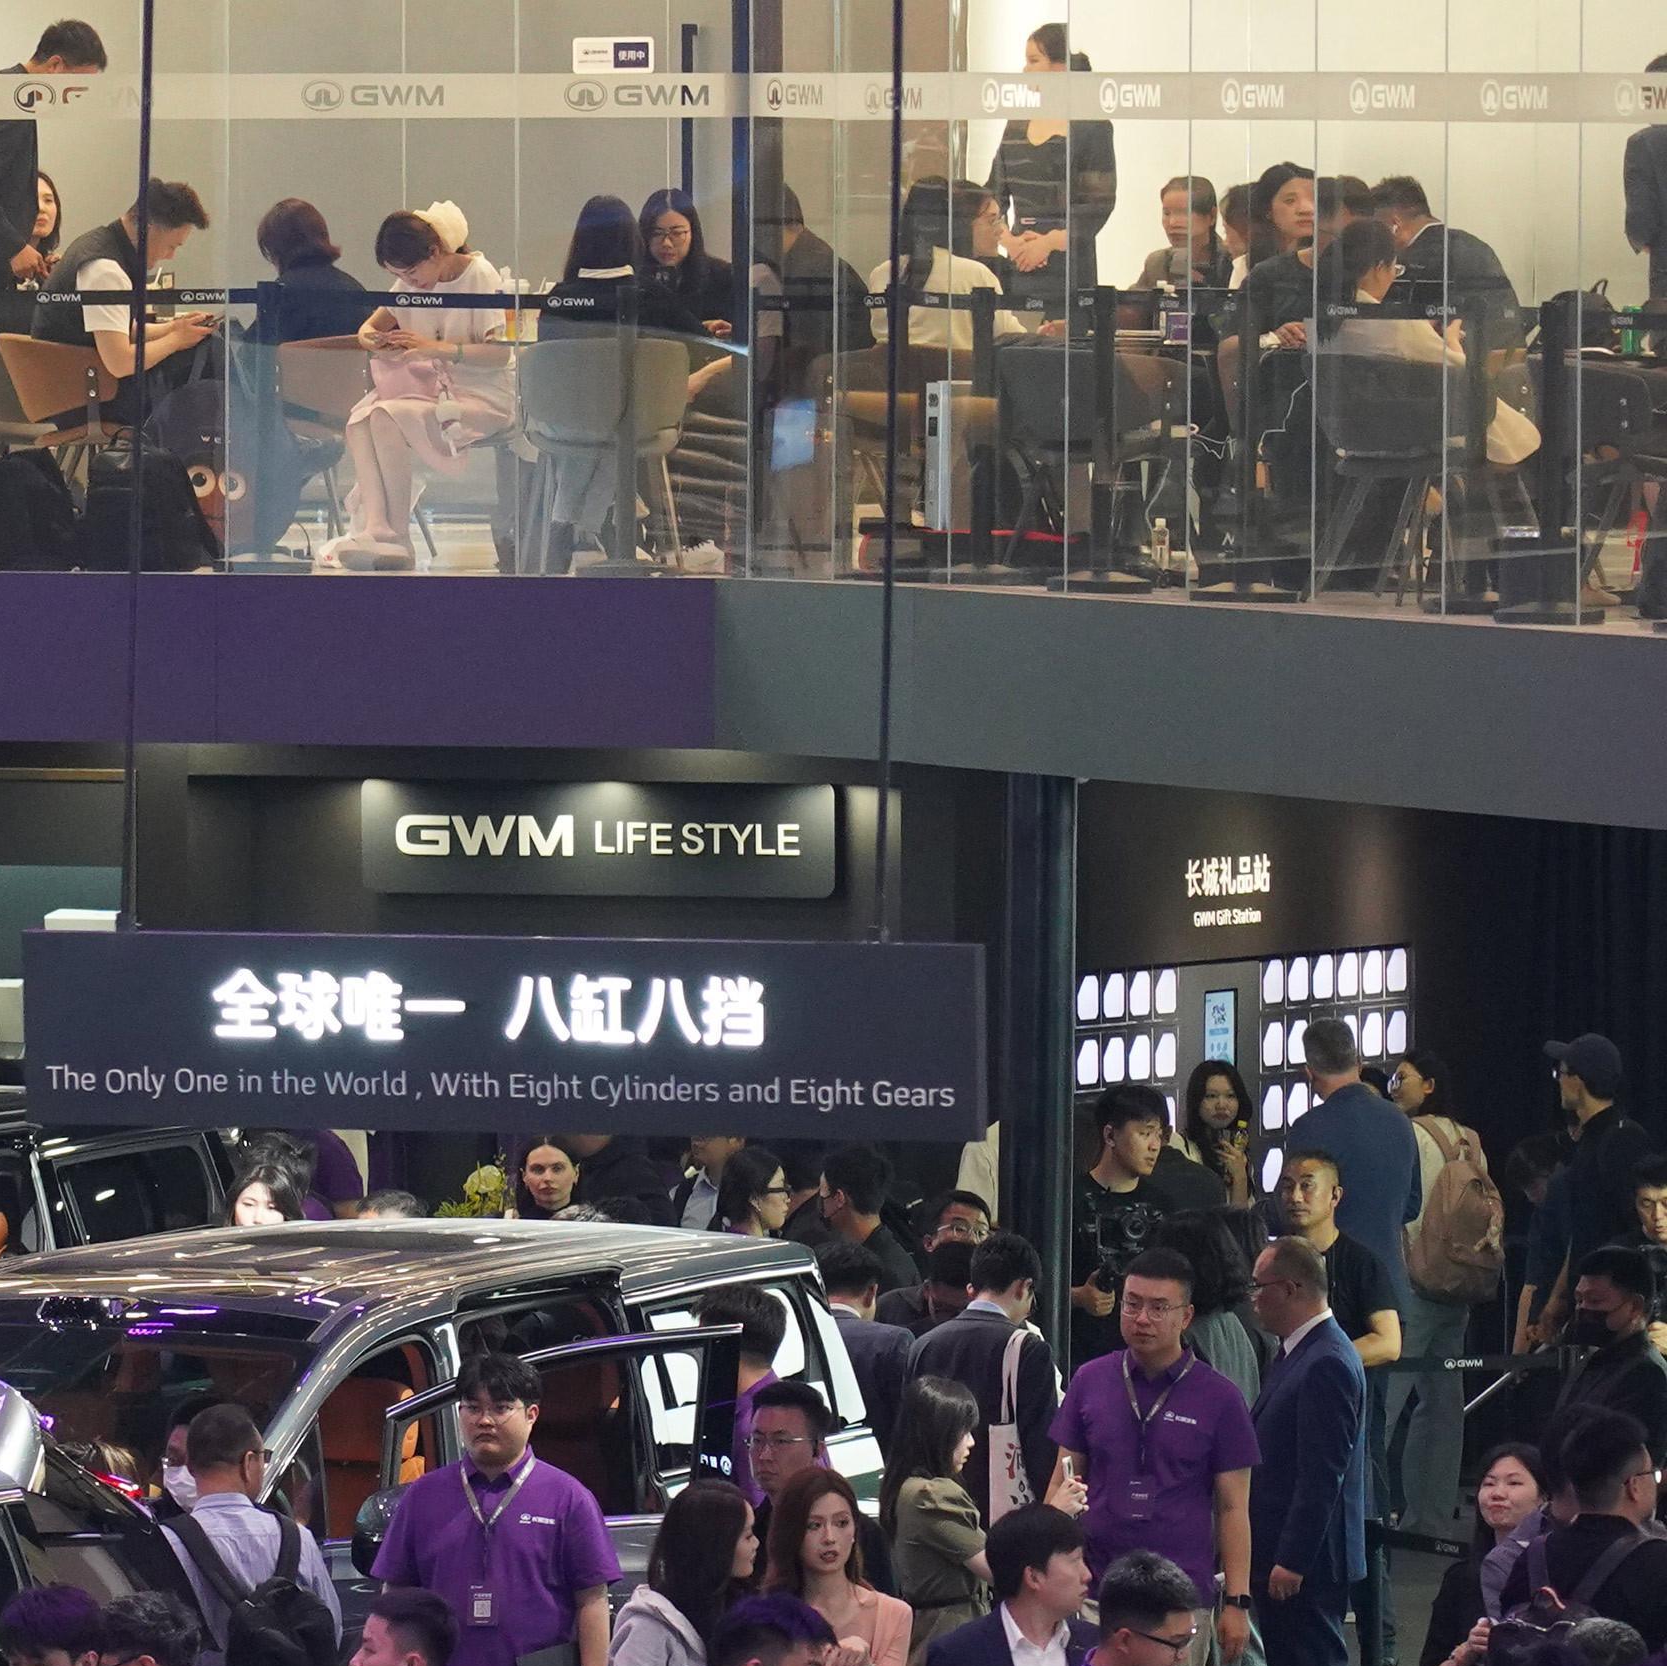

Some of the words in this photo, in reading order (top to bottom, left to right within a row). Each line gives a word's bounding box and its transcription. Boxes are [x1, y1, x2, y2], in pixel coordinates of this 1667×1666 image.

[617, 49, 646, 61] 使用中
[350, 85, 445, 106] GWM
[613, 84, 710, 106] GWM
[785, 84, 824, 106] GWM
[1000, 83, 1041, 108] GWM
[1120, 83, 1161, 108] GWM
[1242, 83, 1284, 109] GWM
[1371, 83, 1415, 109] GWM
[1502, 83, 1548, 109] GWM
[1640, 85, 1667, 110] GW
[51, 292, 82, 303] GWM
[194, 291, 226, 301] GWM
[411, 295, 443, 306] GWM
[562, 296, 595, 307] GWM
[395, 814, 575, 857] GWM
[594, 819, 673, 855] LIFE
[680, 822, 801, 857] STYLE
[1184, 852, 1272, 898] 长城礼品站
[1193, 910, 1216, 928] GWM
[1217, 908, 1233, 926] Gift
[1233, 907, 1262, 925] Station
[211, 966, 467, 1042] 全球唯一
[504, 972, 765, 1047] 八缸八挡
[45, 1063, 97, 1091] The
[104, 1066, 165, 1099] Only
[173, 1067, 229, 1092] One
[237, 1068, 263, 1093] in
[269, 1068, 317, 1095] the
[324, 1070, 407, 1096] World
[429, 1071, 500, 1098] With
[508, 1073, 582, 1106] Eight
[589, 1074, 720, 1106] Cylinders
[727, 1076, 780, 1103] and
[788, 1078, 864, 1111] Eight
[871, 1080, 956, 1107] Gears
[1456, 1359, 1483, 1368] GWM
